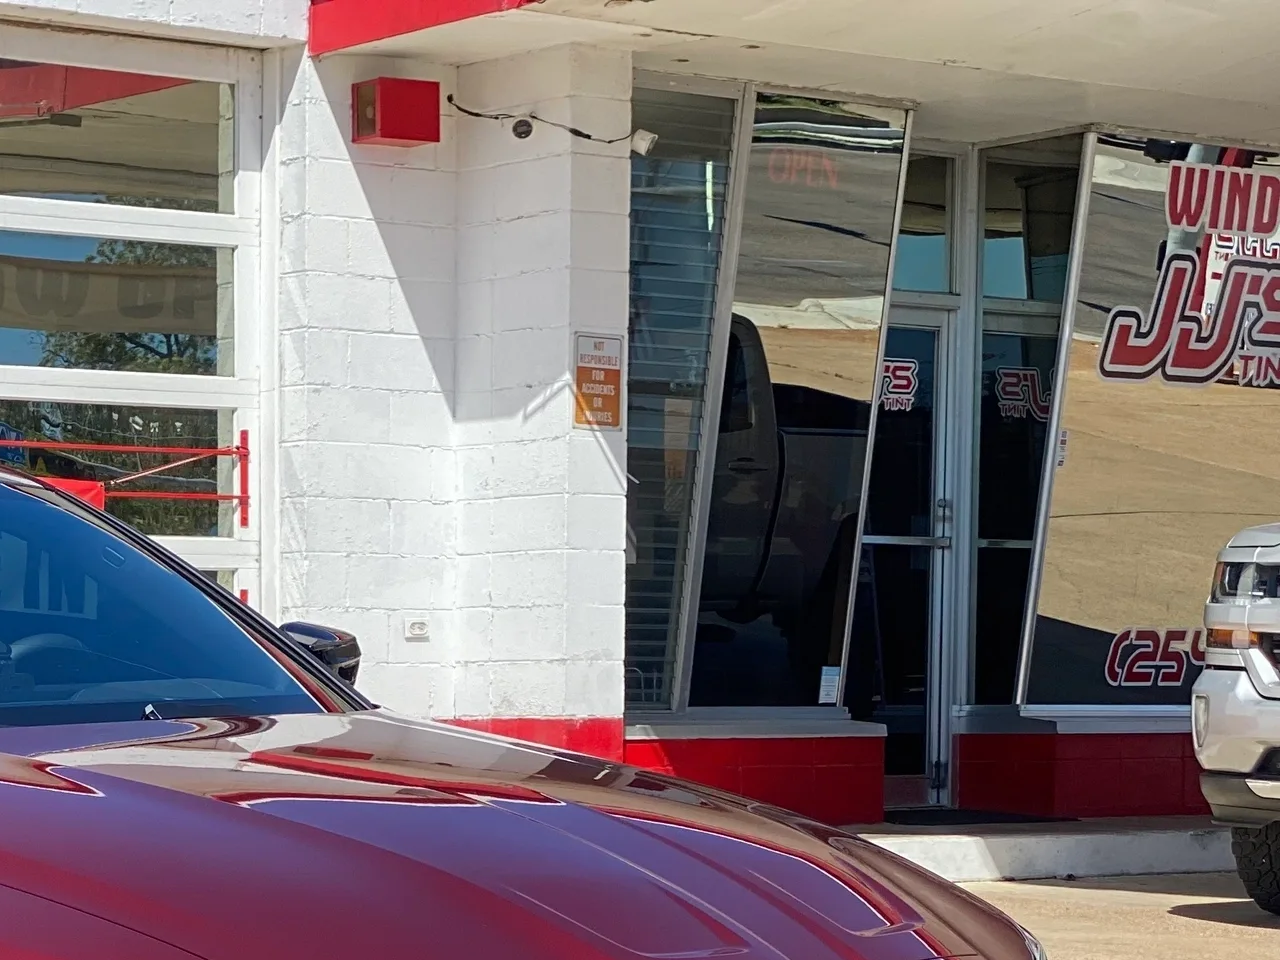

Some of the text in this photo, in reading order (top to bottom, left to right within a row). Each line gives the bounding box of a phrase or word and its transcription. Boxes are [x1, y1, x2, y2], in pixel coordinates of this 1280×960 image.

[768, 148, 838, 189] OPEN
[1099, 252, 1280, 386] JJ'
[593, 341, 605, 352] NOT
[579, 353, 619, 367] RESPONSIBLE
[592, 369, 605, 381] FOR
[581, 383, 615, 396] ACCIDENTS
[593, 396, 602, 408] OR
[883, 396, 914, 411] TINT
